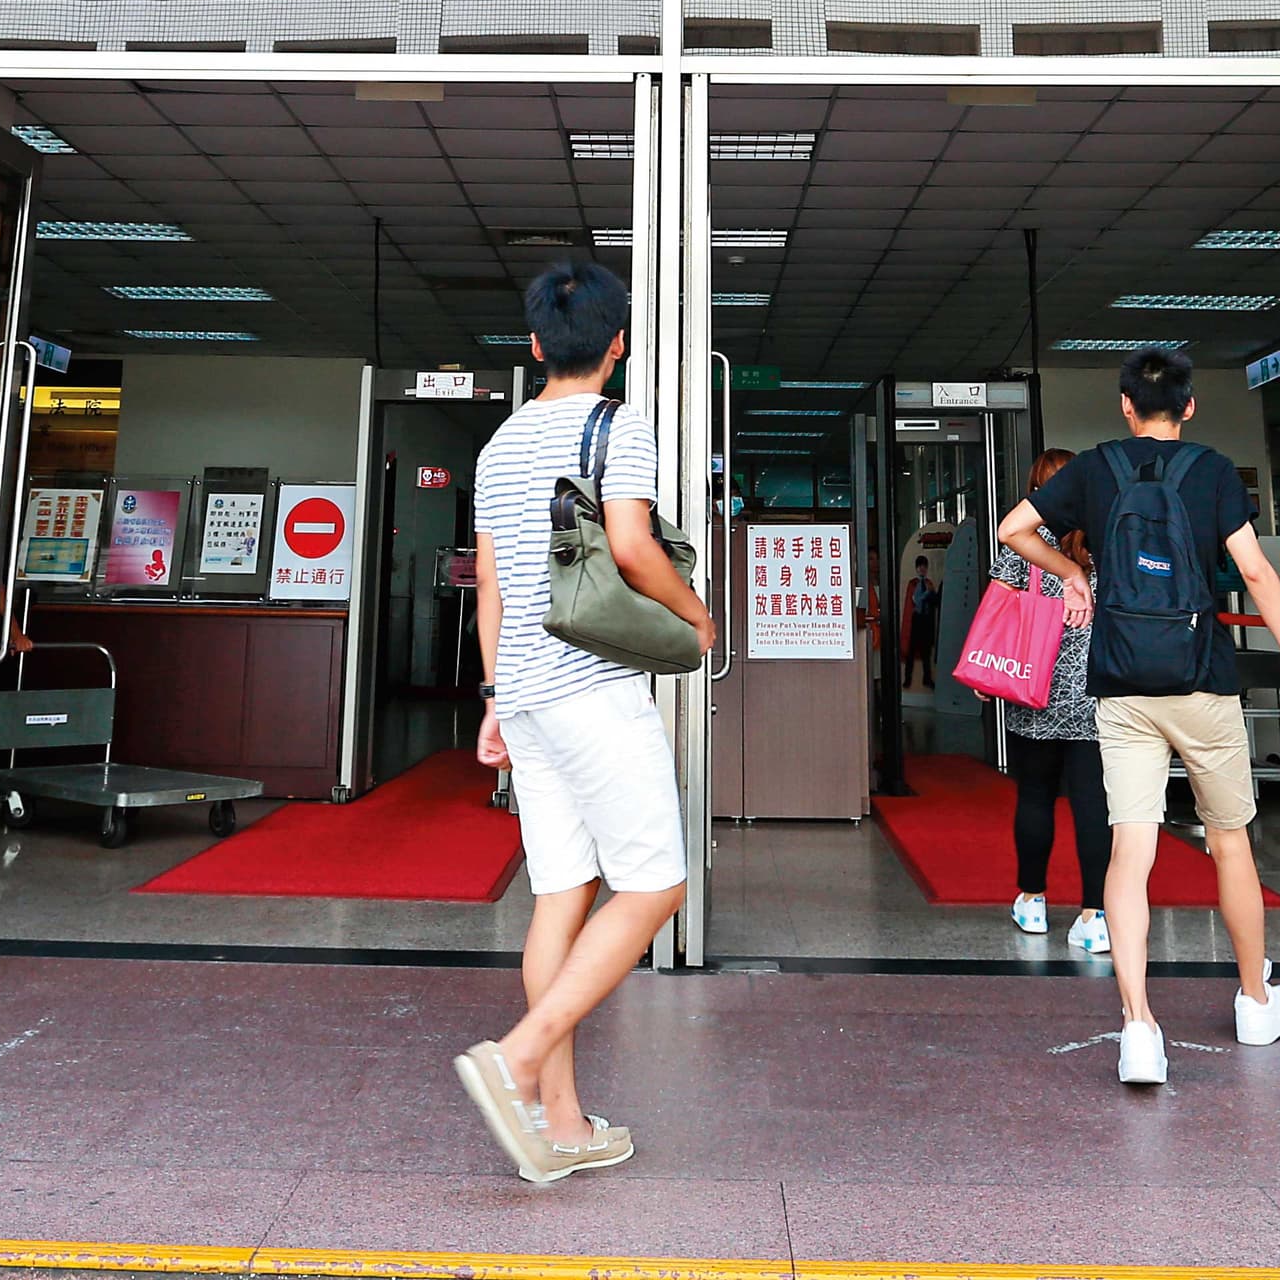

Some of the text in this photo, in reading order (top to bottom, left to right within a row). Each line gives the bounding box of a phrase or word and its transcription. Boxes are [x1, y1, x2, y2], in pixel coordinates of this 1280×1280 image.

[423, 375, 466, 388] 出口
[937, 385, 980, 396] 入口
[940, 397, 978, 405] Entrance
[755, 537, 841, 559] 請將手提包
[276, 568, 345, 585] 禁止通行
[755, 565, 842, 587] 隨身物品
[755, 593, 843, 616] 放置籃內檢查
[832, 622, 846, 630] Bag
[968, 650, 1033, 680] CLINIQUE
